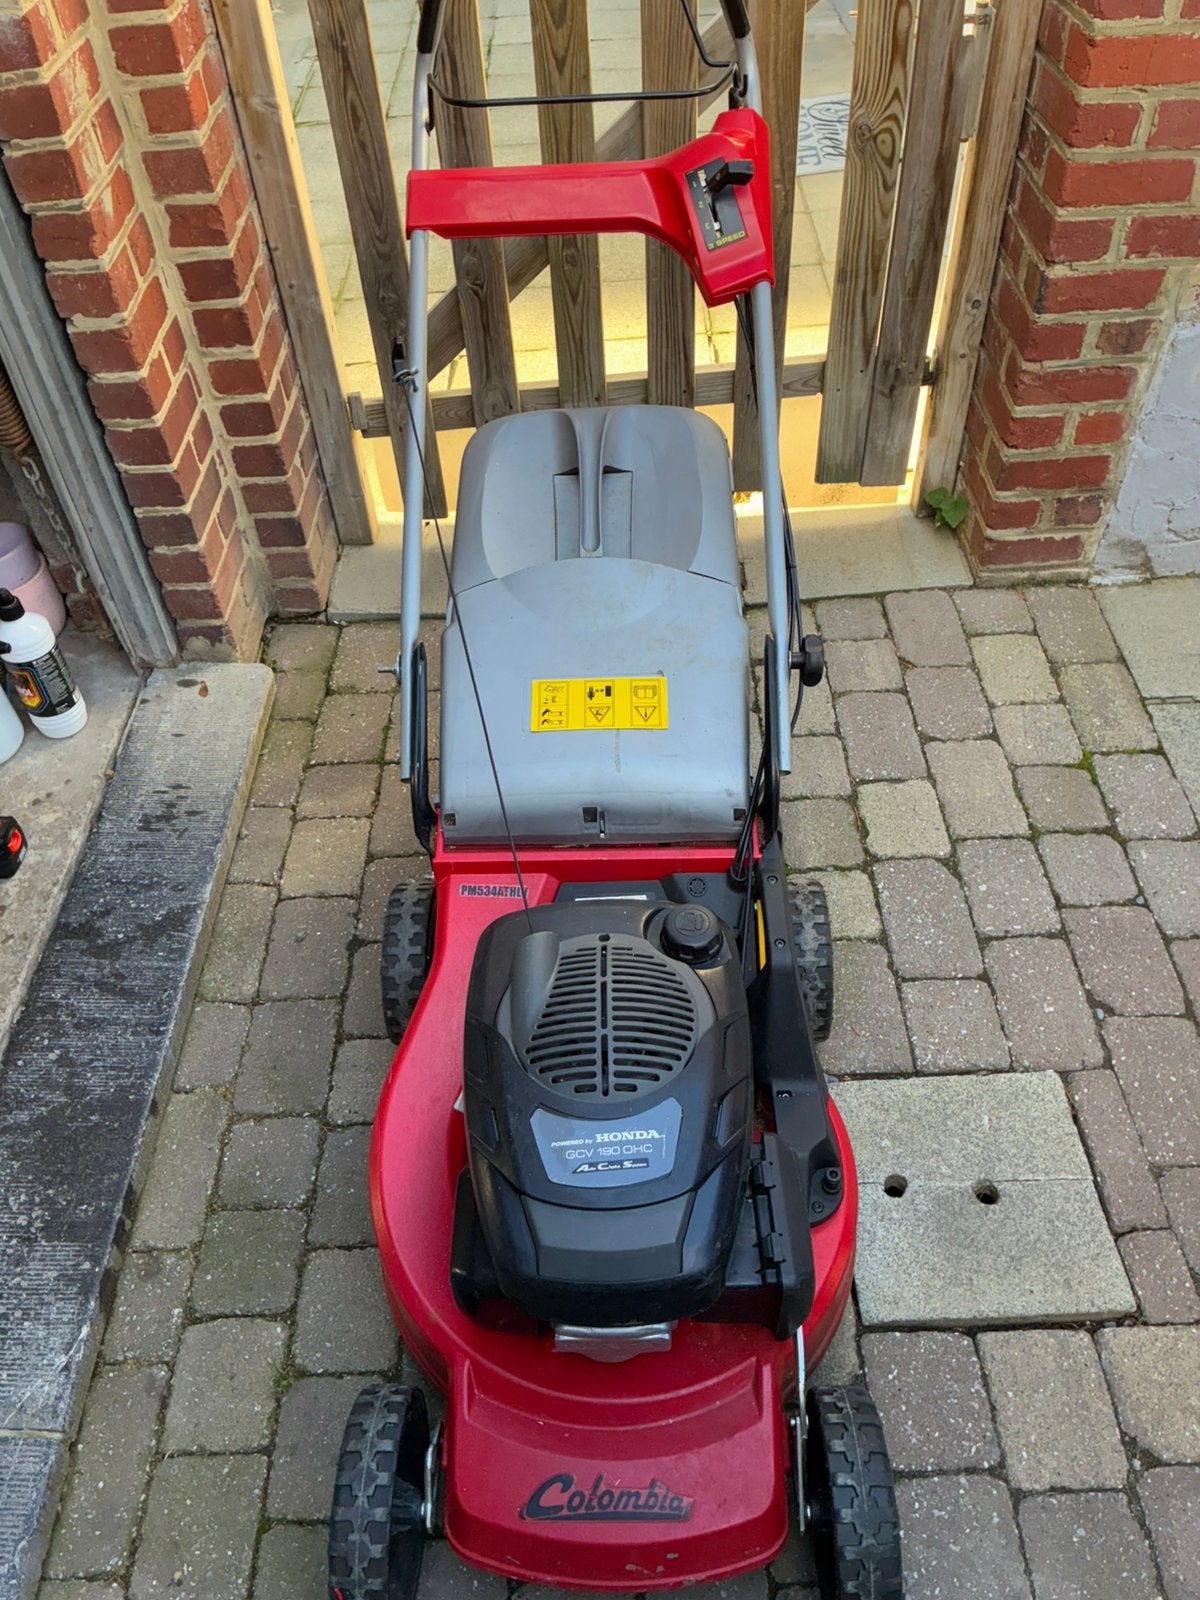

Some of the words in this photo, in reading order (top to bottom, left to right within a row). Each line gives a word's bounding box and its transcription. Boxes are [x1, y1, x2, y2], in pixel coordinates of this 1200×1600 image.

[707, 242, 715, 250] 3
[716, 230, 746, 247] SPEED
[551, 1139, 584, 1147] POWERED
[595, 1129, 661, 1143] HONDA
[565, 1149, 594, 1159] GCV
[596, 1146, 621, 1156] 190
[623, 1144, 653, 1154] OHC
[522, 1472, 688, 1520] Colombia
